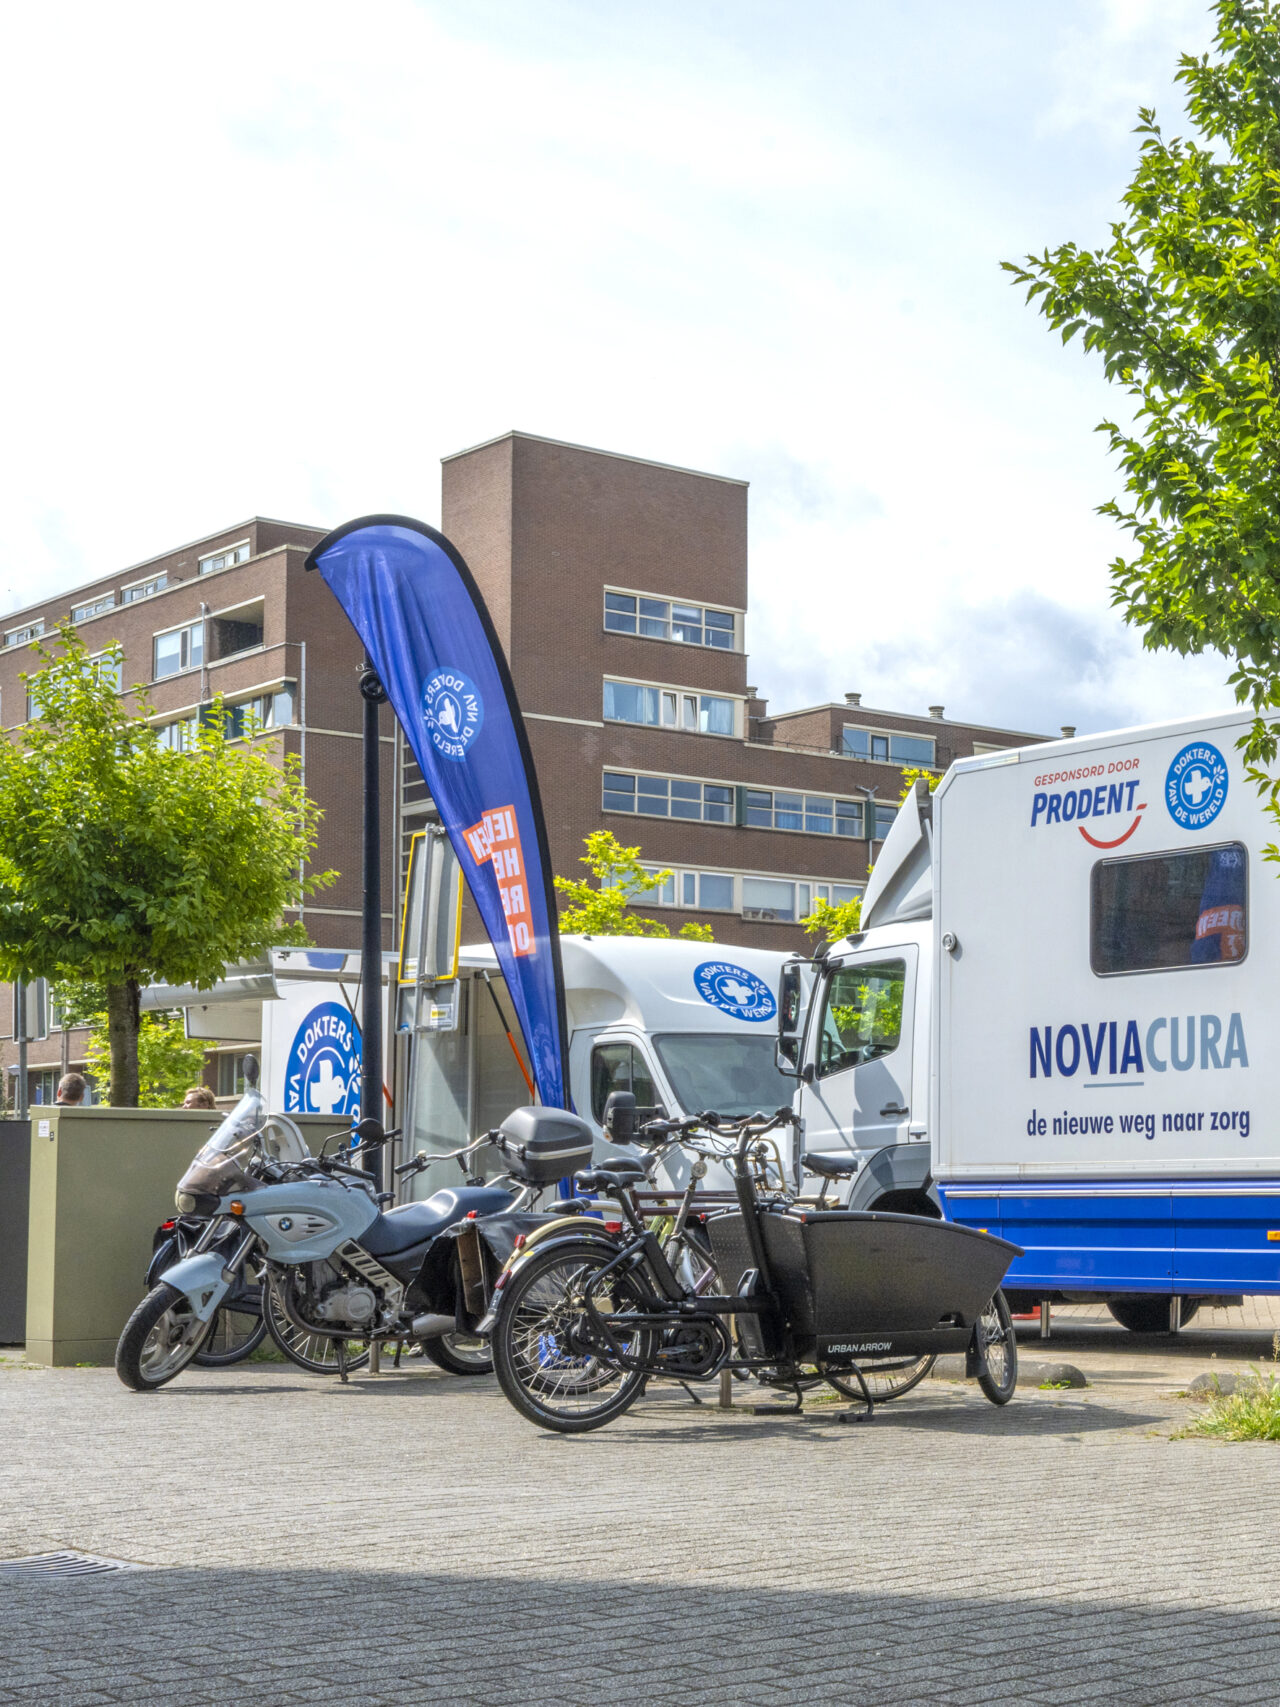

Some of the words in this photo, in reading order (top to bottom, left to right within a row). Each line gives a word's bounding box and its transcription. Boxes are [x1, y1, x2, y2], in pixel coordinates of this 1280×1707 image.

[1034, 764, 1105, 787] GESPONSORD
[1107, 758, 1140, 774] DOOR
[1173, 748, 1217, 775] DOKTERS
[1030, 779, 1140, 827] PRODENT
[1168, 779, 1179, 807] VAN
[1174, 806, 1189, 823] DE
[1189, 788, 1224, 825] WERELD
[700, 965, 749, 980] DOKTERS
[700, 982, 719, 1003] VAN
[720, 1003, 738, 1014] DE
[297, 1015, 354, 1064] DOKTERS
[1029, 1012, 1249, 1079] NOVIACURA
[1027, 1109, 1047, 1136] de
[1053, 1110, 1114, 1136] nieuwe
[1119, 1113, 1155, 1140] weg
[1162, 1112, 1204, 1132] naar
[1210, 1110, 1250, 1138] zorg
[827, 1344, 859, 1354] URBAN
[859, 1342, 892, 1352] ARROW
